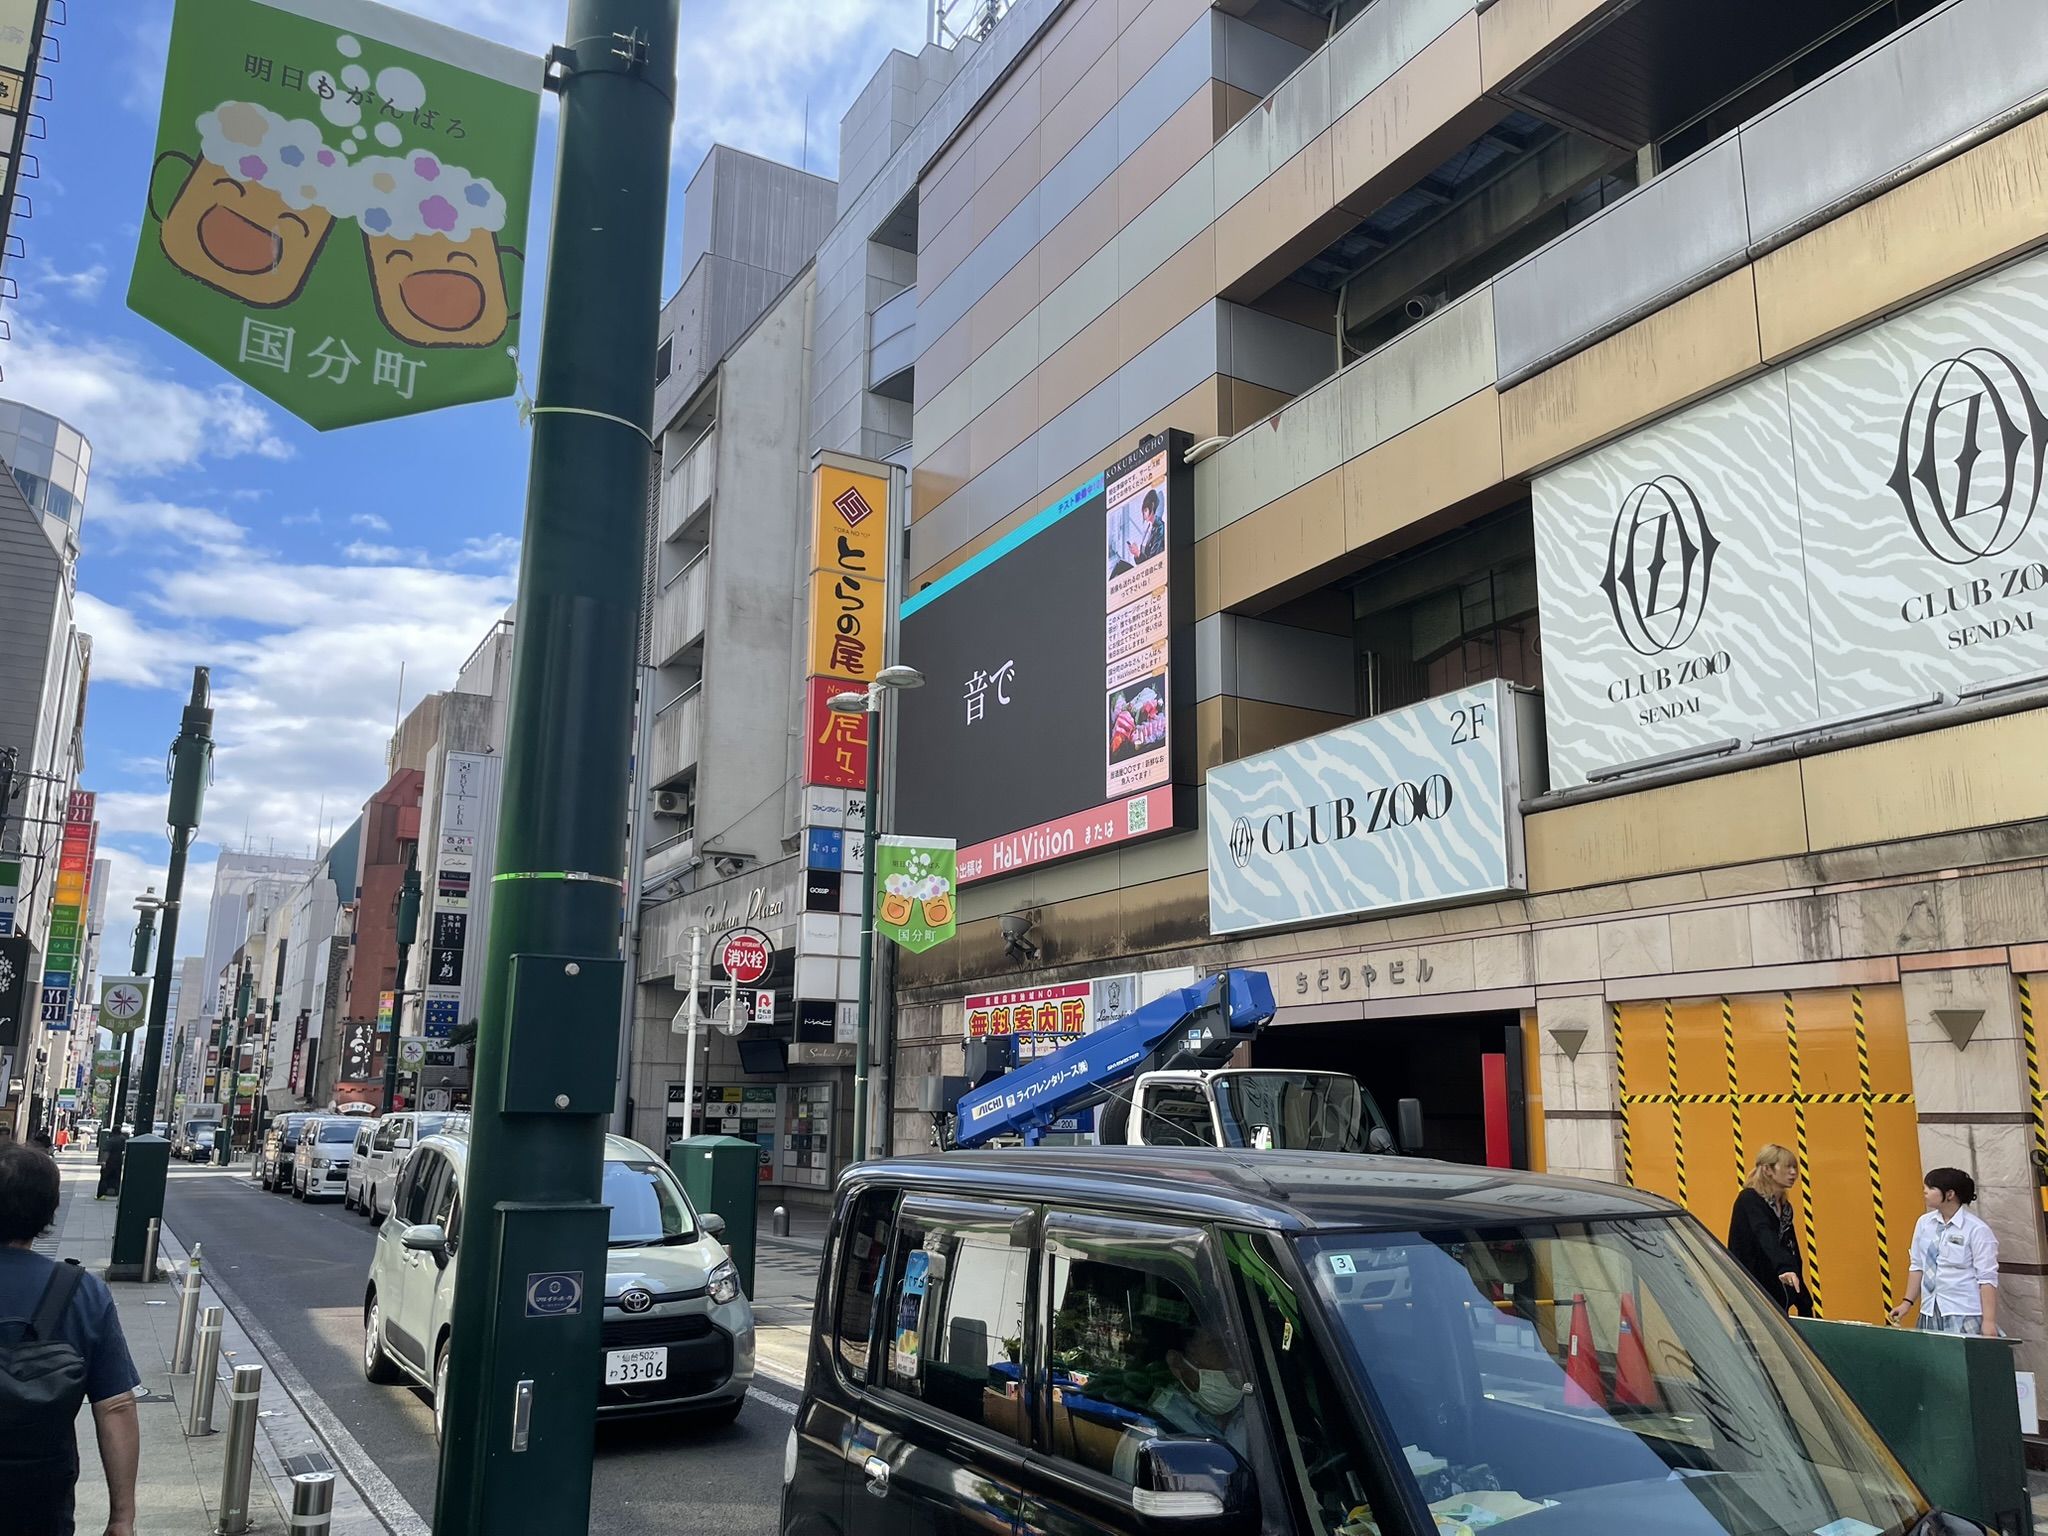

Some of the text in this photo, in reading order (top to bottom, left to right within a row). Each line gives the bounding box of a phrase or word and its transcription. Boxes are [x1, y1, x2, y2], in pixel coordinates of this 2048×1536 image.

[244, 53, 467, 140] 明日もがんばろ
[238, 316, 428, 400] 国分町
[1105, 434, 1164, 480] KOKUBUNCHO
[829, 535, 866, 674] とらの尾
[1901, 562, 2048, 624] CLUB ZO
[1948, 610, 2036, 650] SENDAI
[963, 659, 1015, 726] 音で
[1607, 650, 1731, 703] CLUB ZOO
[1450, 703, 1487, 746] 2F
[1639, 696, 1701, 726] SENDAI
[1084, 819, 1114, 846] または
[1261, 773, 1453, 855] CLUB ZOO
[743, 886, 784, 934] Plaza
[898, 928, 936, 942] 国分町
[727, 948, 764, 968] 消火栓
[1295, 958, 1434, 994] ちどりやビル
[45, 1005, 60, 1019] 21
[106, 1019, 137, 1029] 国分町
[969, 998, 1086, 1044] 無料案内所
[1061, 1119, 1074, 1129] 200
[1336, 1257, 1347, 1269] 3
[620, 1361, 663, 1381] 33-06
